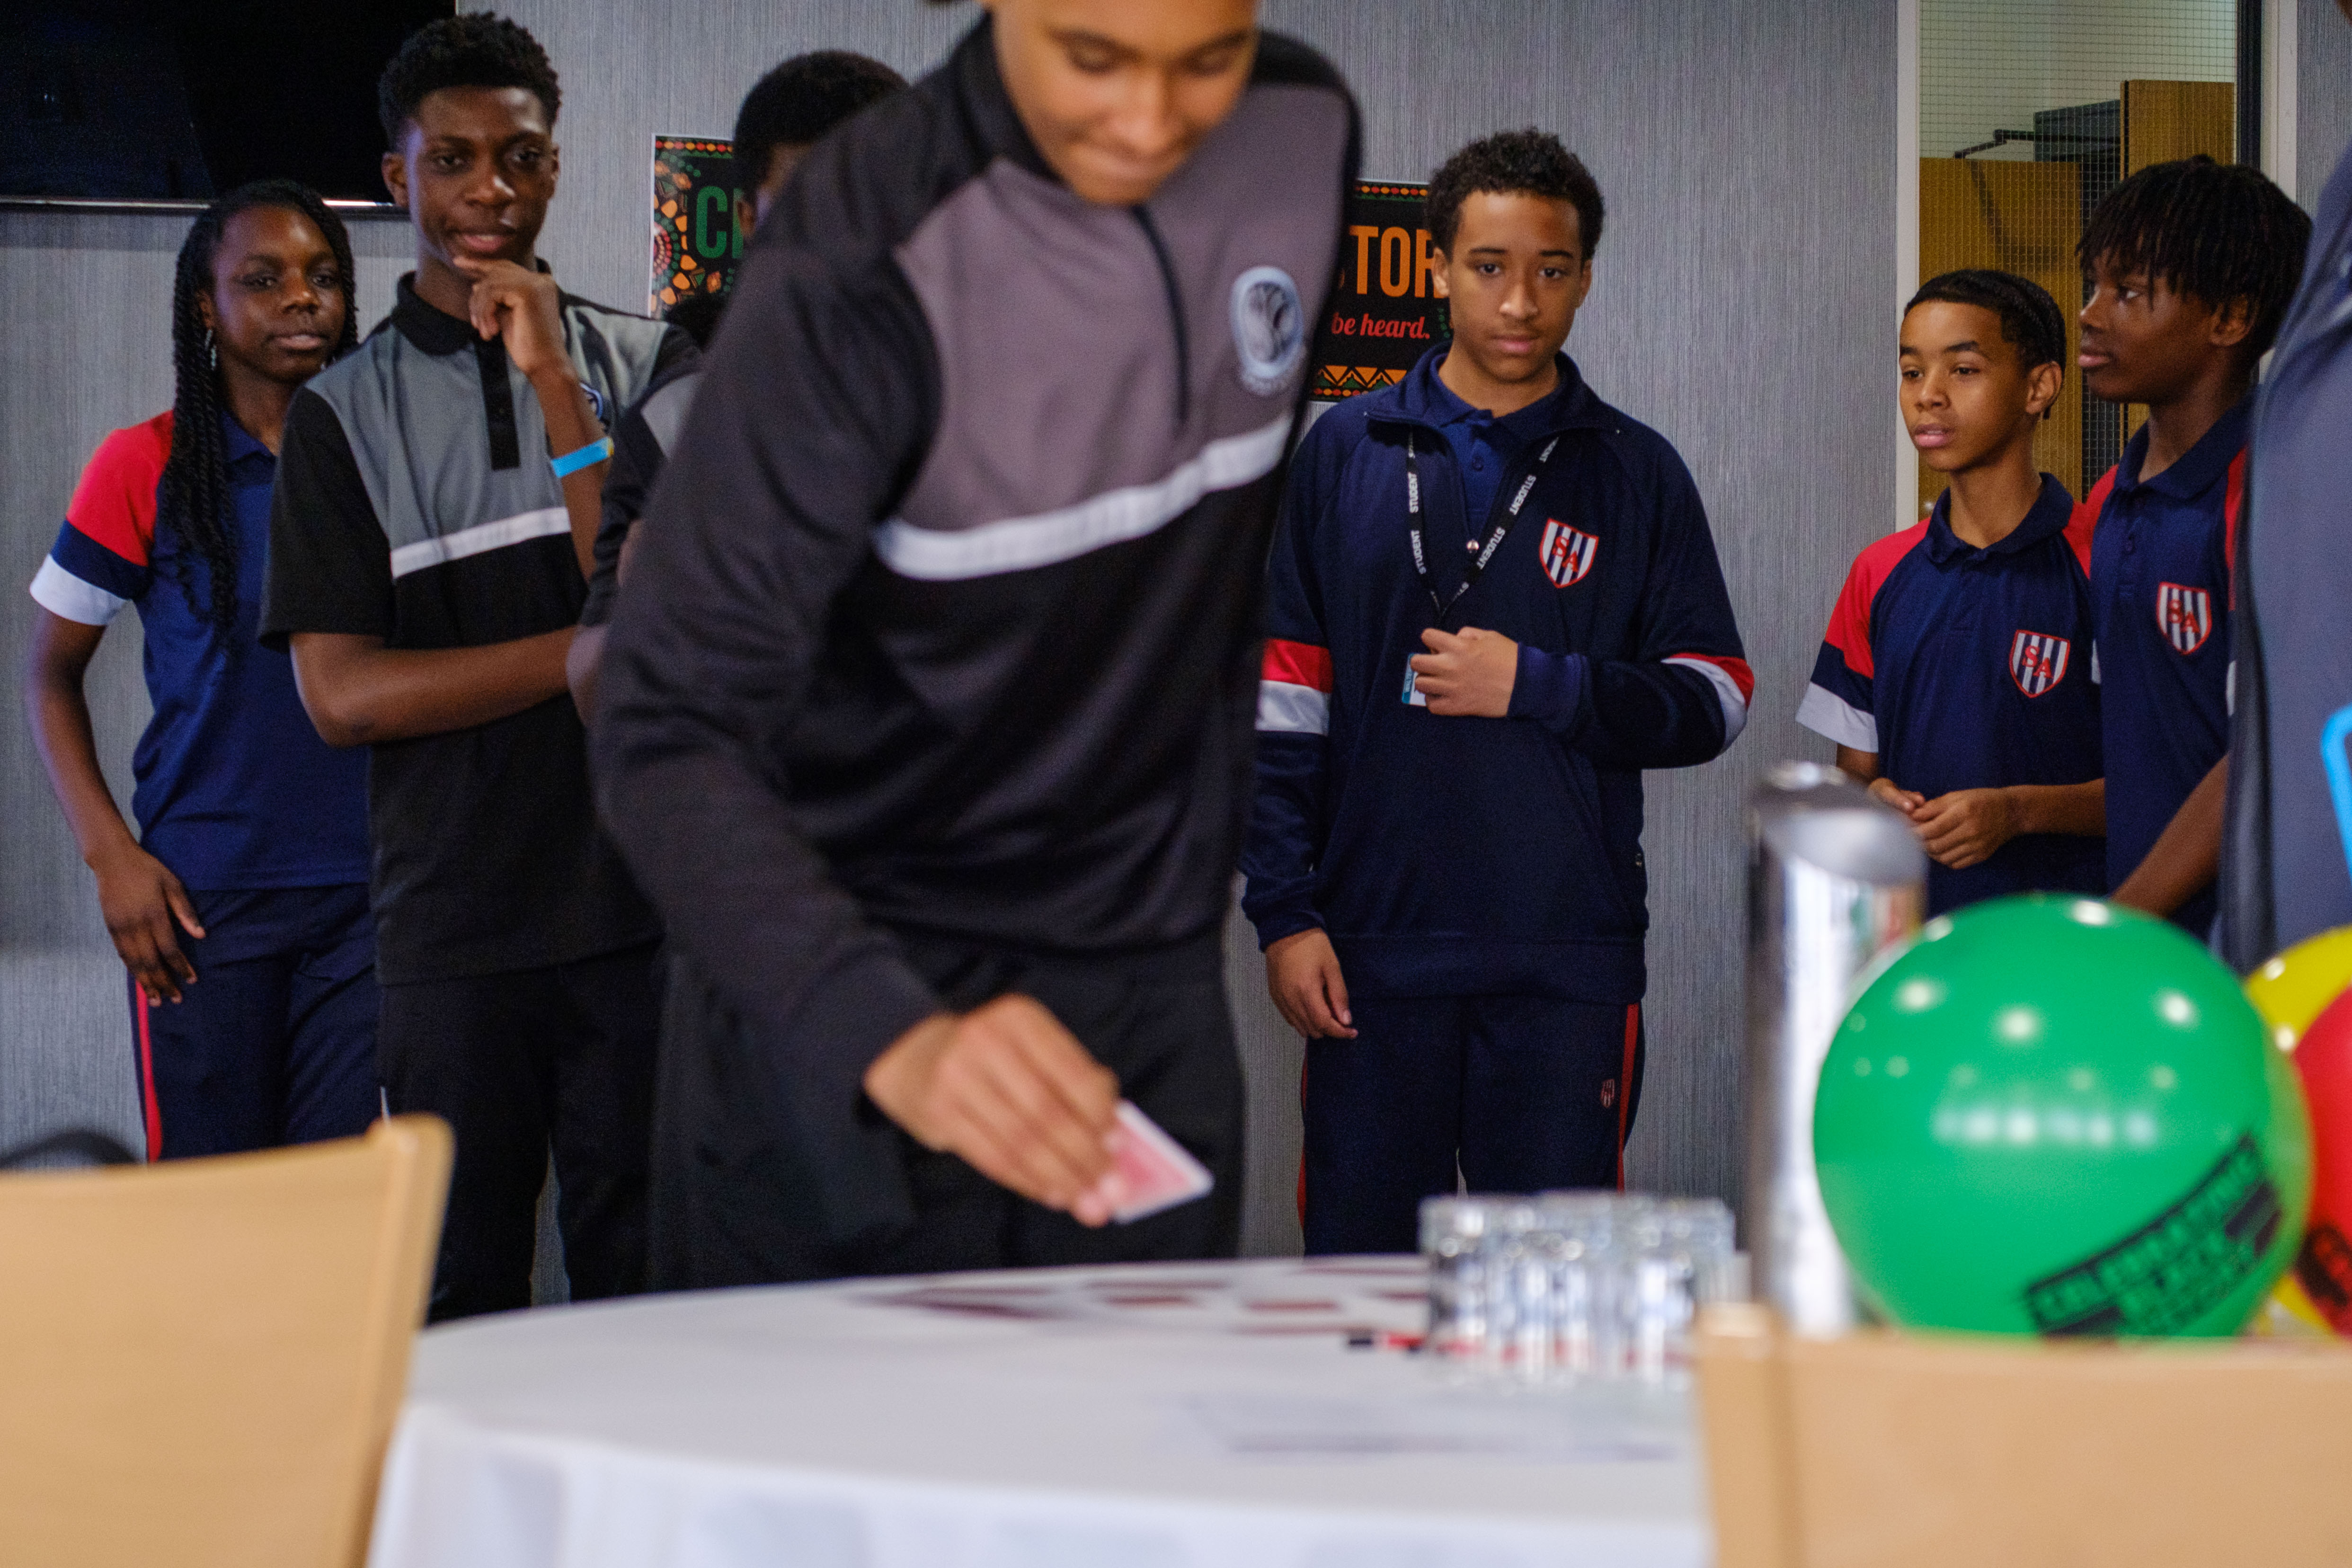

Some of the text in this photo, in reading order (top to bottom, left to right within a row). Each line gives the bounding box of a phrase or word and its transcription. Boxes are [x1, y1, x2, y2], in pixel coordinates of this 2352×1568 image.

[1331, 312, 1430, 339] be heard.
[1408, 472, 1419, 513] STUDENT
[1509, 475, 1536, 515] STUDENT
[1411, 530, 1427, 575] STUDENT
[1476, 526, 1505, 569] STUDENT
